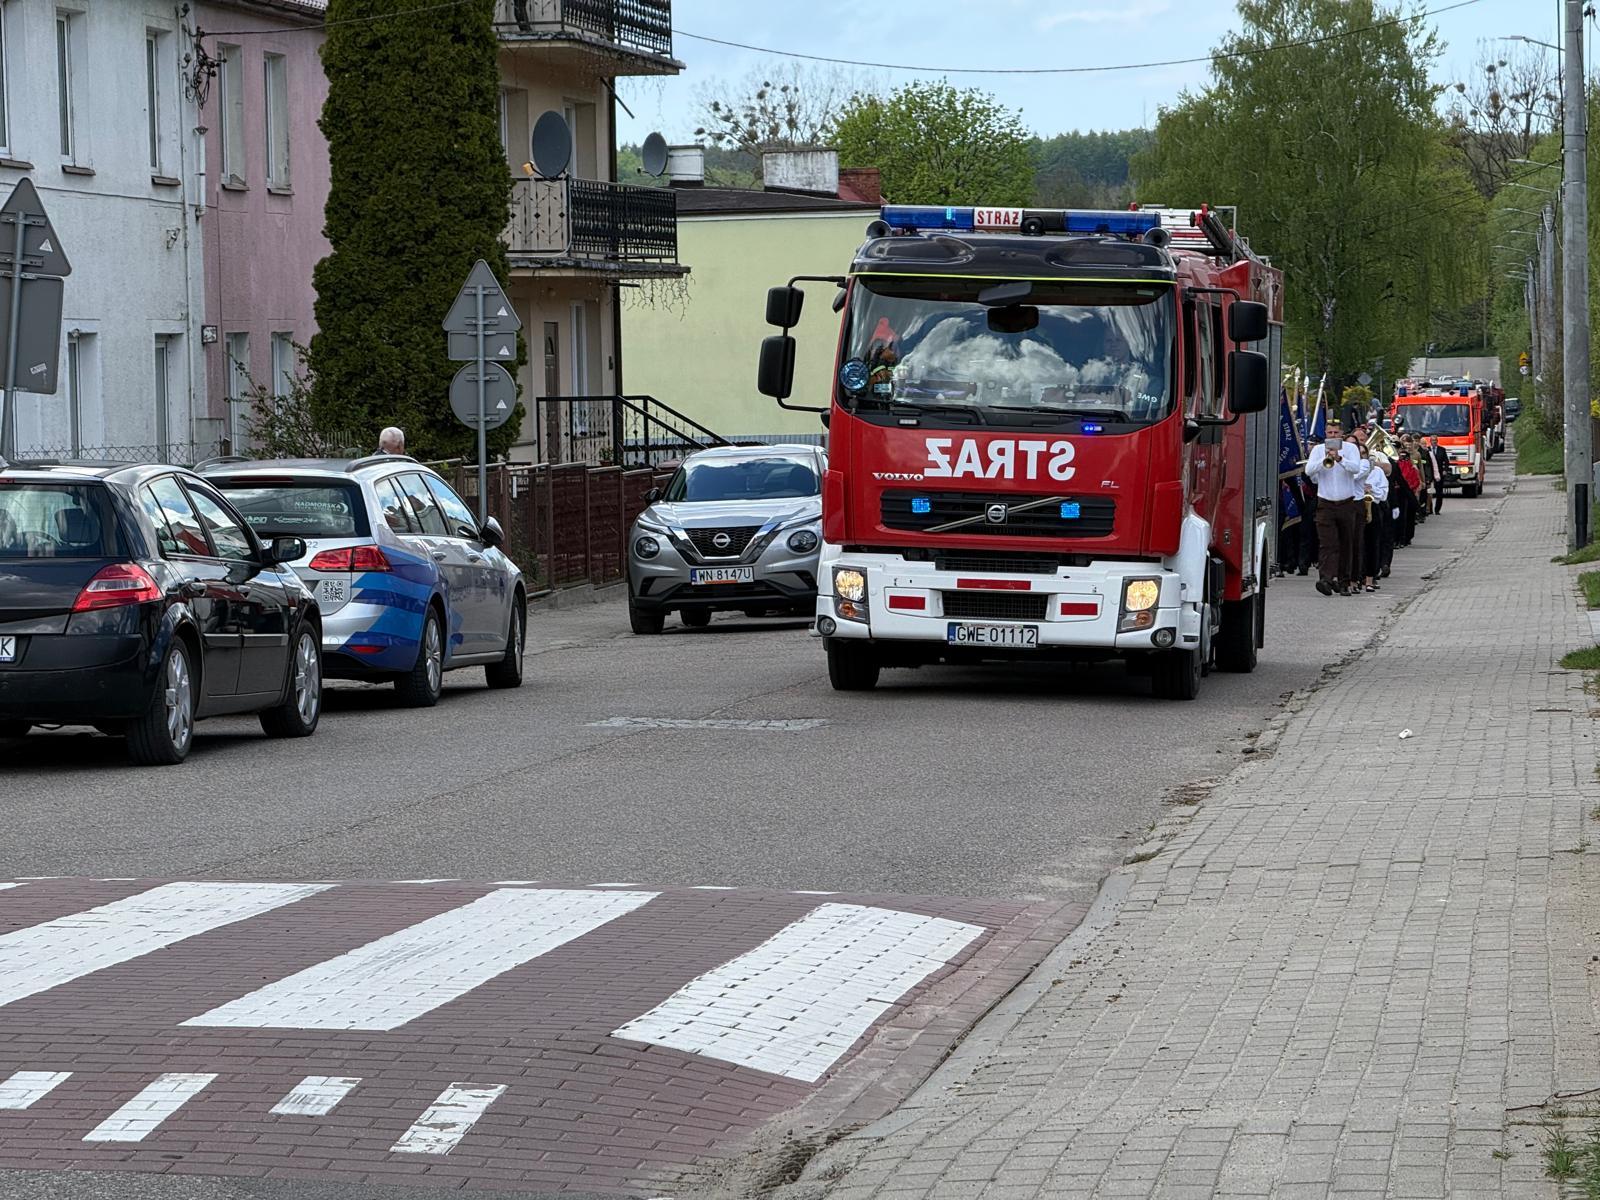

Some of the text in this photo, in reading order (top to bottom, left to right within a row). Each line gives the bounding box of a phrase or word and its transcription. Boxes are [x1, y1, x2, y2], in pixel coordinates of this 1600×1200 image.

[872, 472, 924, 481] VOLVO
[1100, 480, 1120, 488] FL
[294, 501, 341, 509] NADMORSKA
[698, 568, 751, 580] WN 8147U
[957, 626, 1036, 644] GWE 01112
